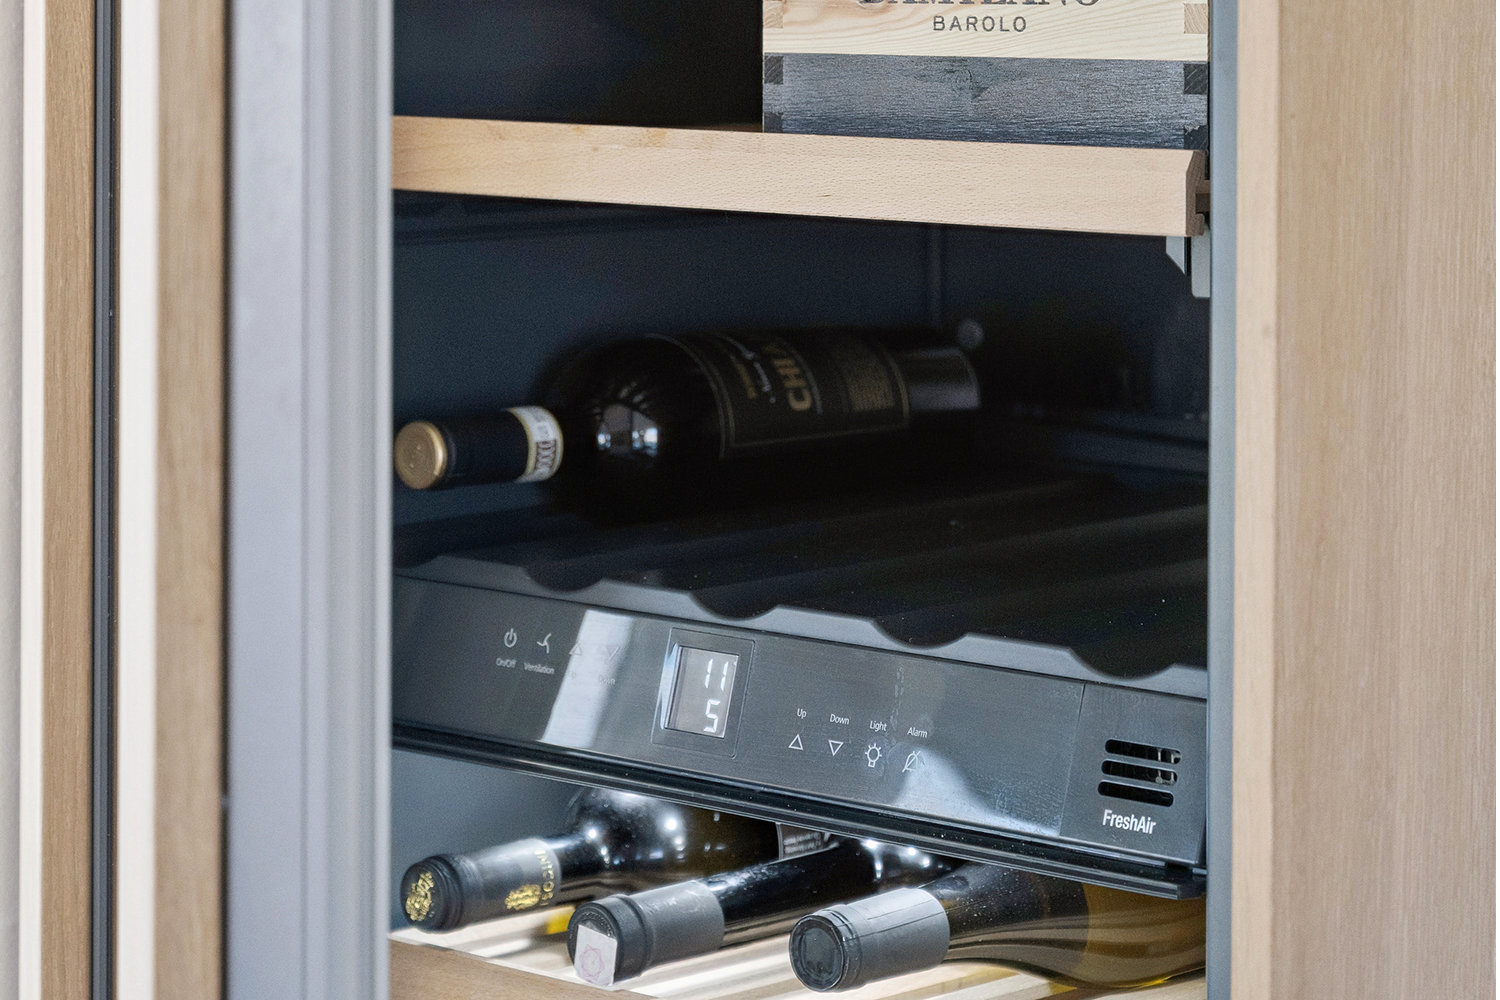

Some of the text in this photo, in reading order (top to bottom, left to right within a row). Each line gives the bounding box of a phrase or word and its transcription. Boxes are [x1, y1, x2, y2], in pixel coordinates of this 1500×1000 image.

[932, 15, 1027, 33] BAROLO
[704, 658, 729, 691] 11
[703, 699, 721, 733] 5
[796, 708, 807, 719] Up
[829, 713, 850, 725] Down
[869, 720, 887, 732] Light
[907, 727, 928, 738] Alarm
[1102, 809, 1157, 835] FreshAir
